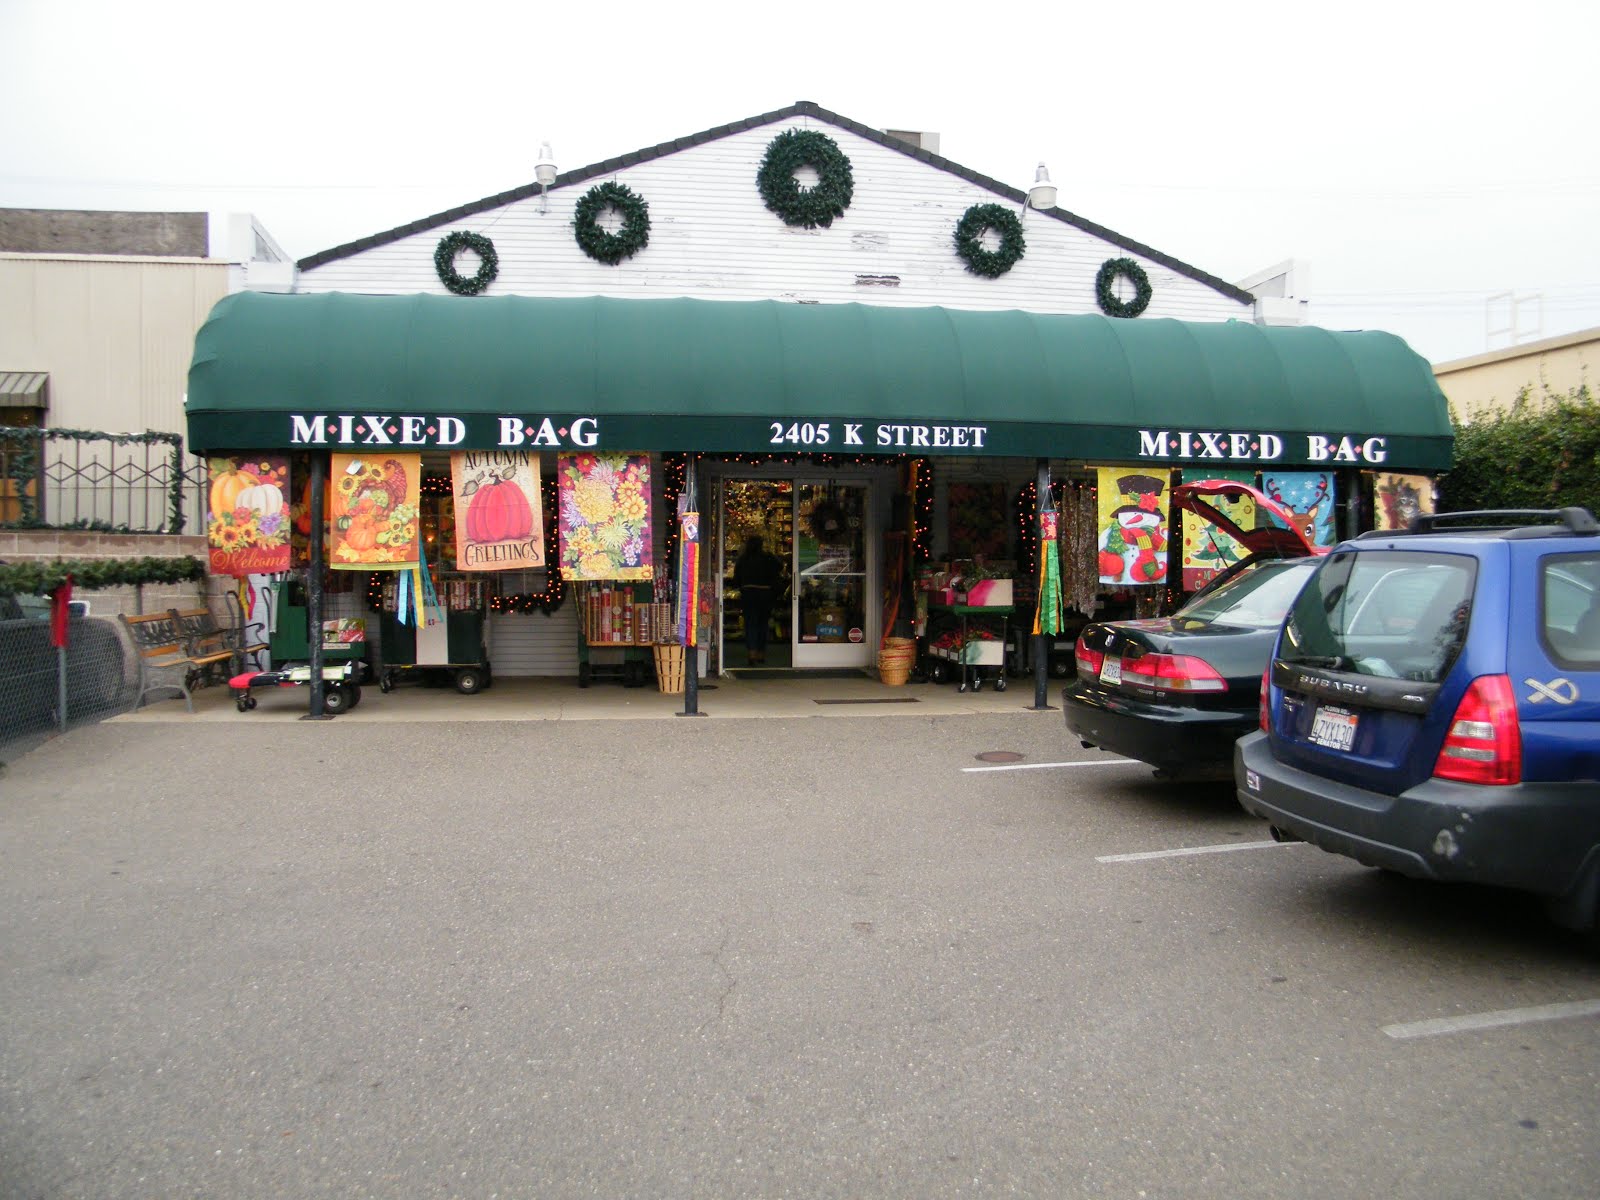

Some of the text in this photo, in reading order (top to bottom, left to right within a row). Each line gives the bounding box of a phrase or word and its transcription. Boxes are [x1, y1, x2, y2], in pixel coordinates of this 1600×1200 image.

[498, 416, 599, 447] BAG
[769, 422, 987, 448] 2405 K STREET
[464, 450, 530, 470] AUTUMN
[1306, 434, 1387, 463] BAG
[211, 548, 290, 571] Welcome
[464, 537, 540, 565] GREETINGS
[1299, 673, 1367, 692] SUBARU
